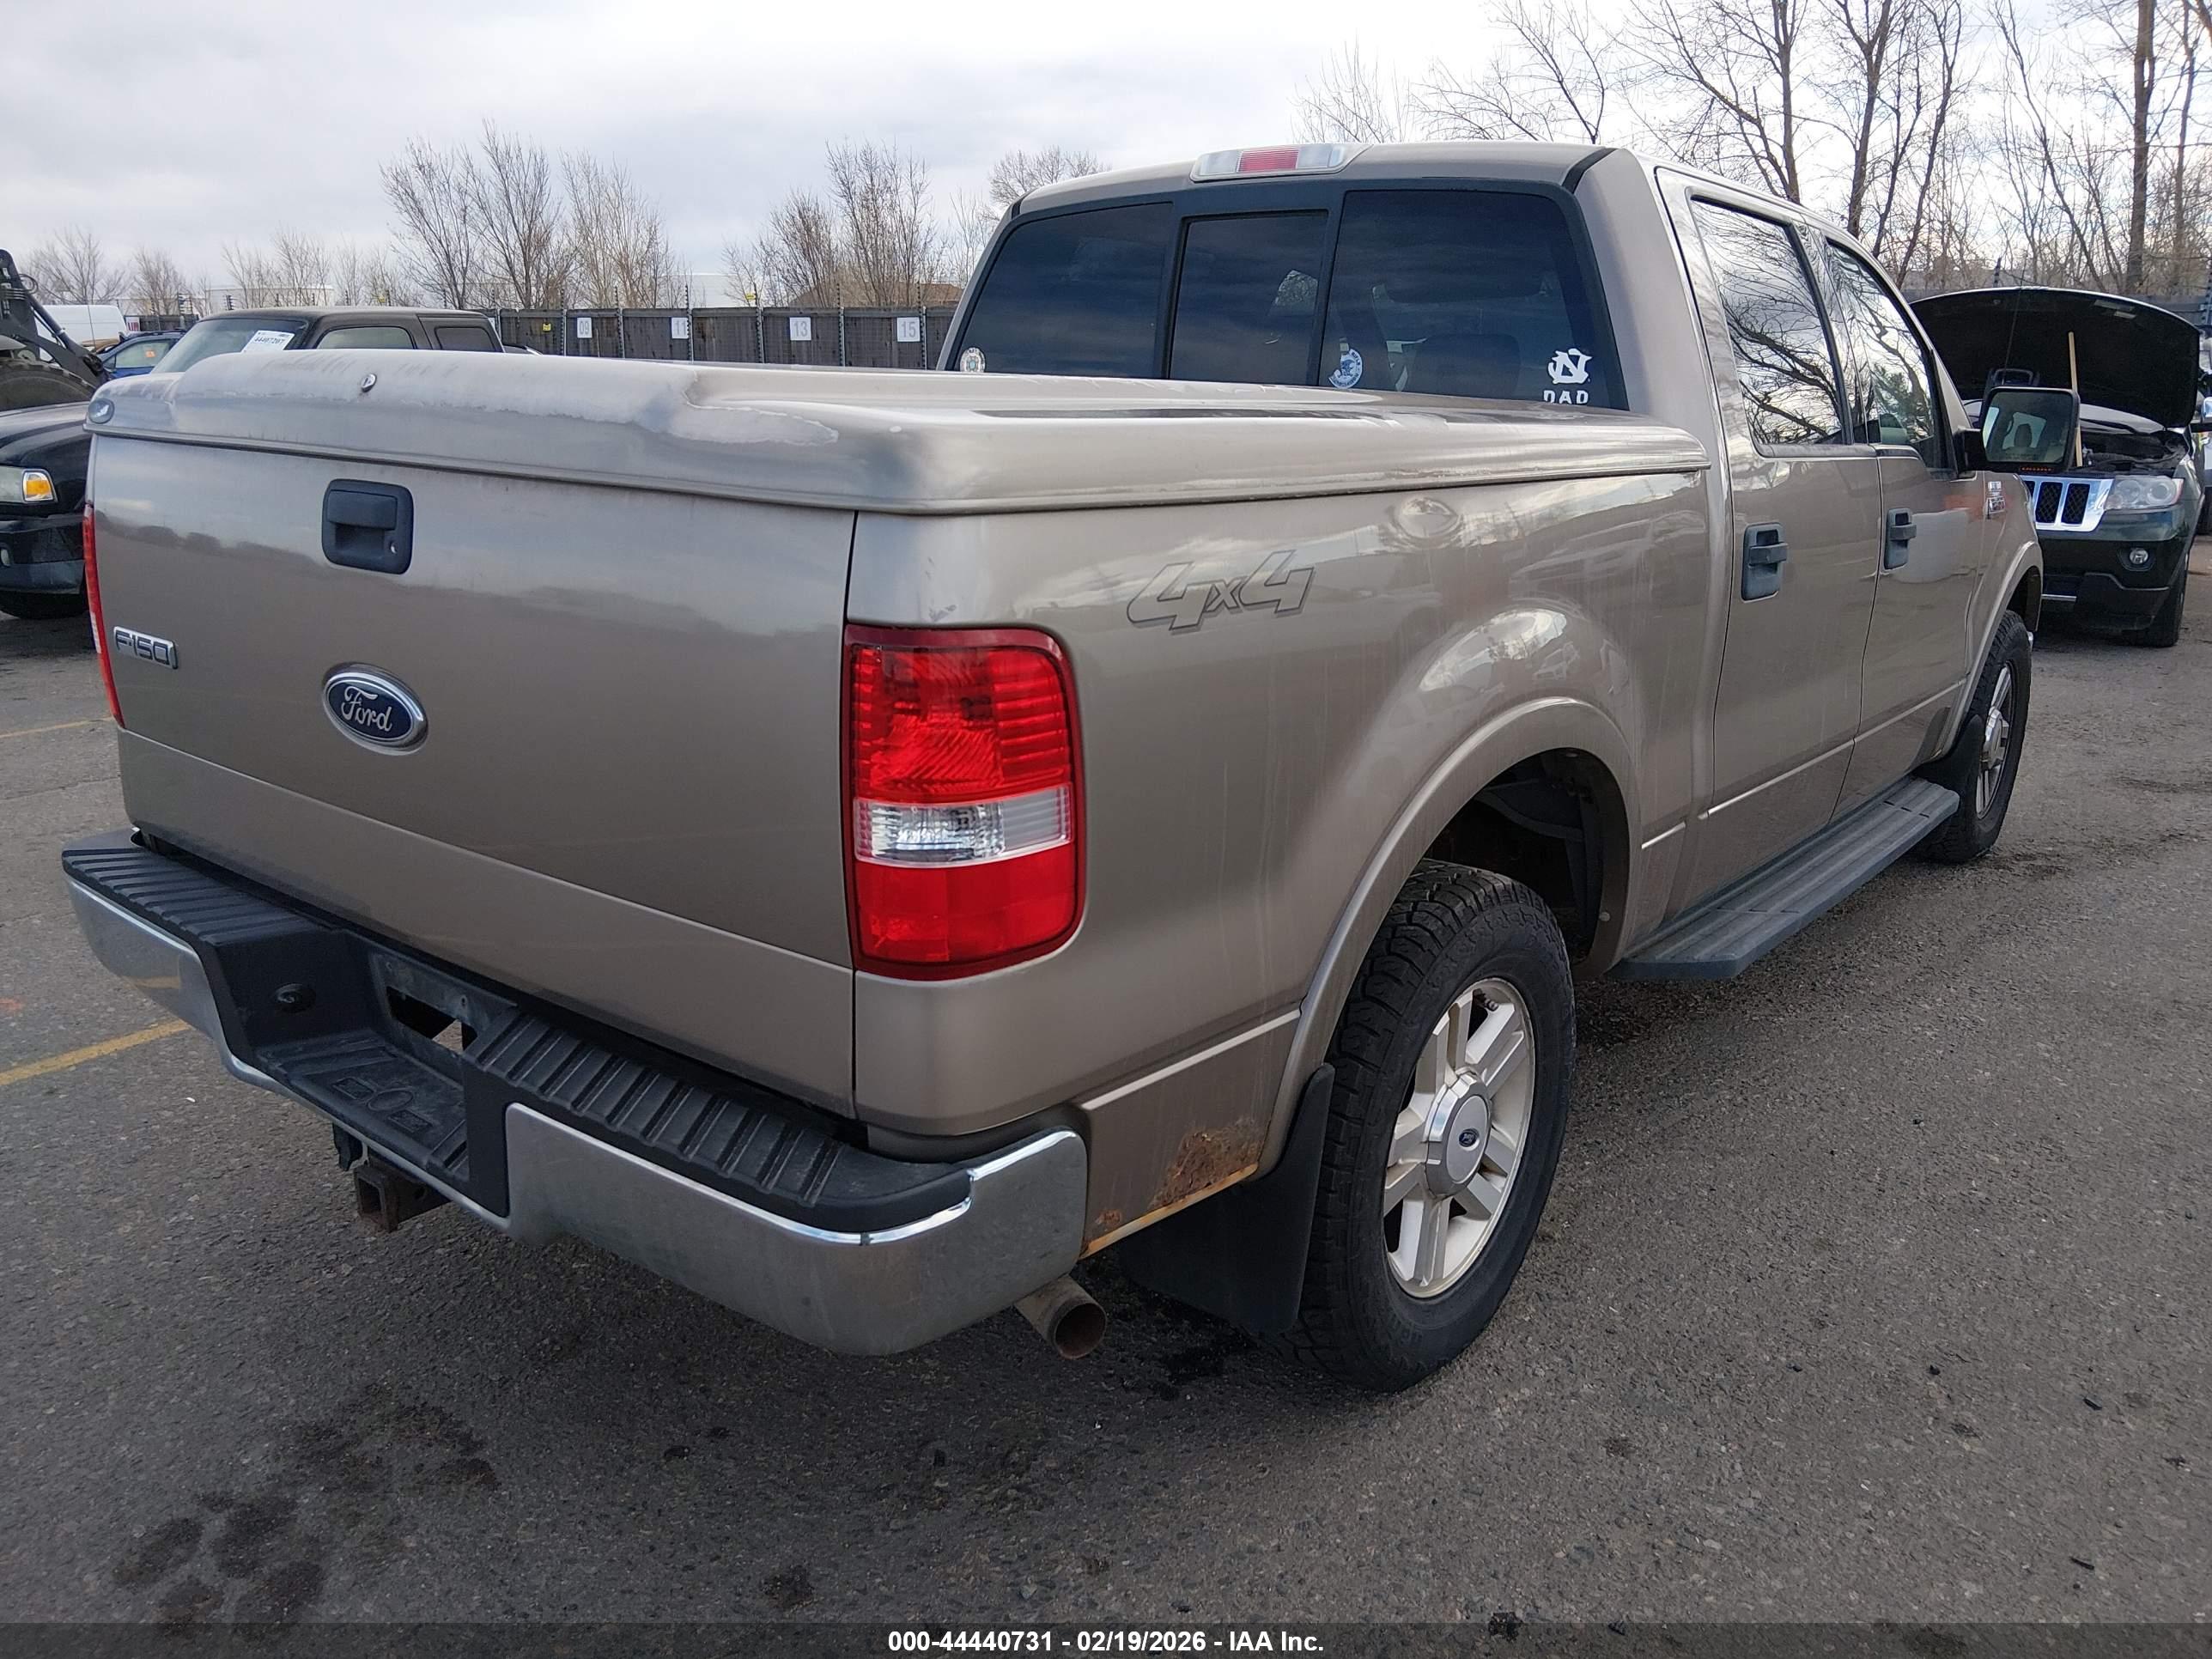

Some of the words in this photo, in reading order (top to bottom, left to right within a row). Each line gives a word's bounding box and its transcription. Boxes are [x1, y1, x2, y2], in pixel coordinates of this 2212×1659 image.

[579, 320, 590, 335] 09
[793, 321, 808, 337] 13
[902, 321, 916, 337] 15
[1543, 390, 1589, 404] DAD
[341, 685, 393, 732] Ford
